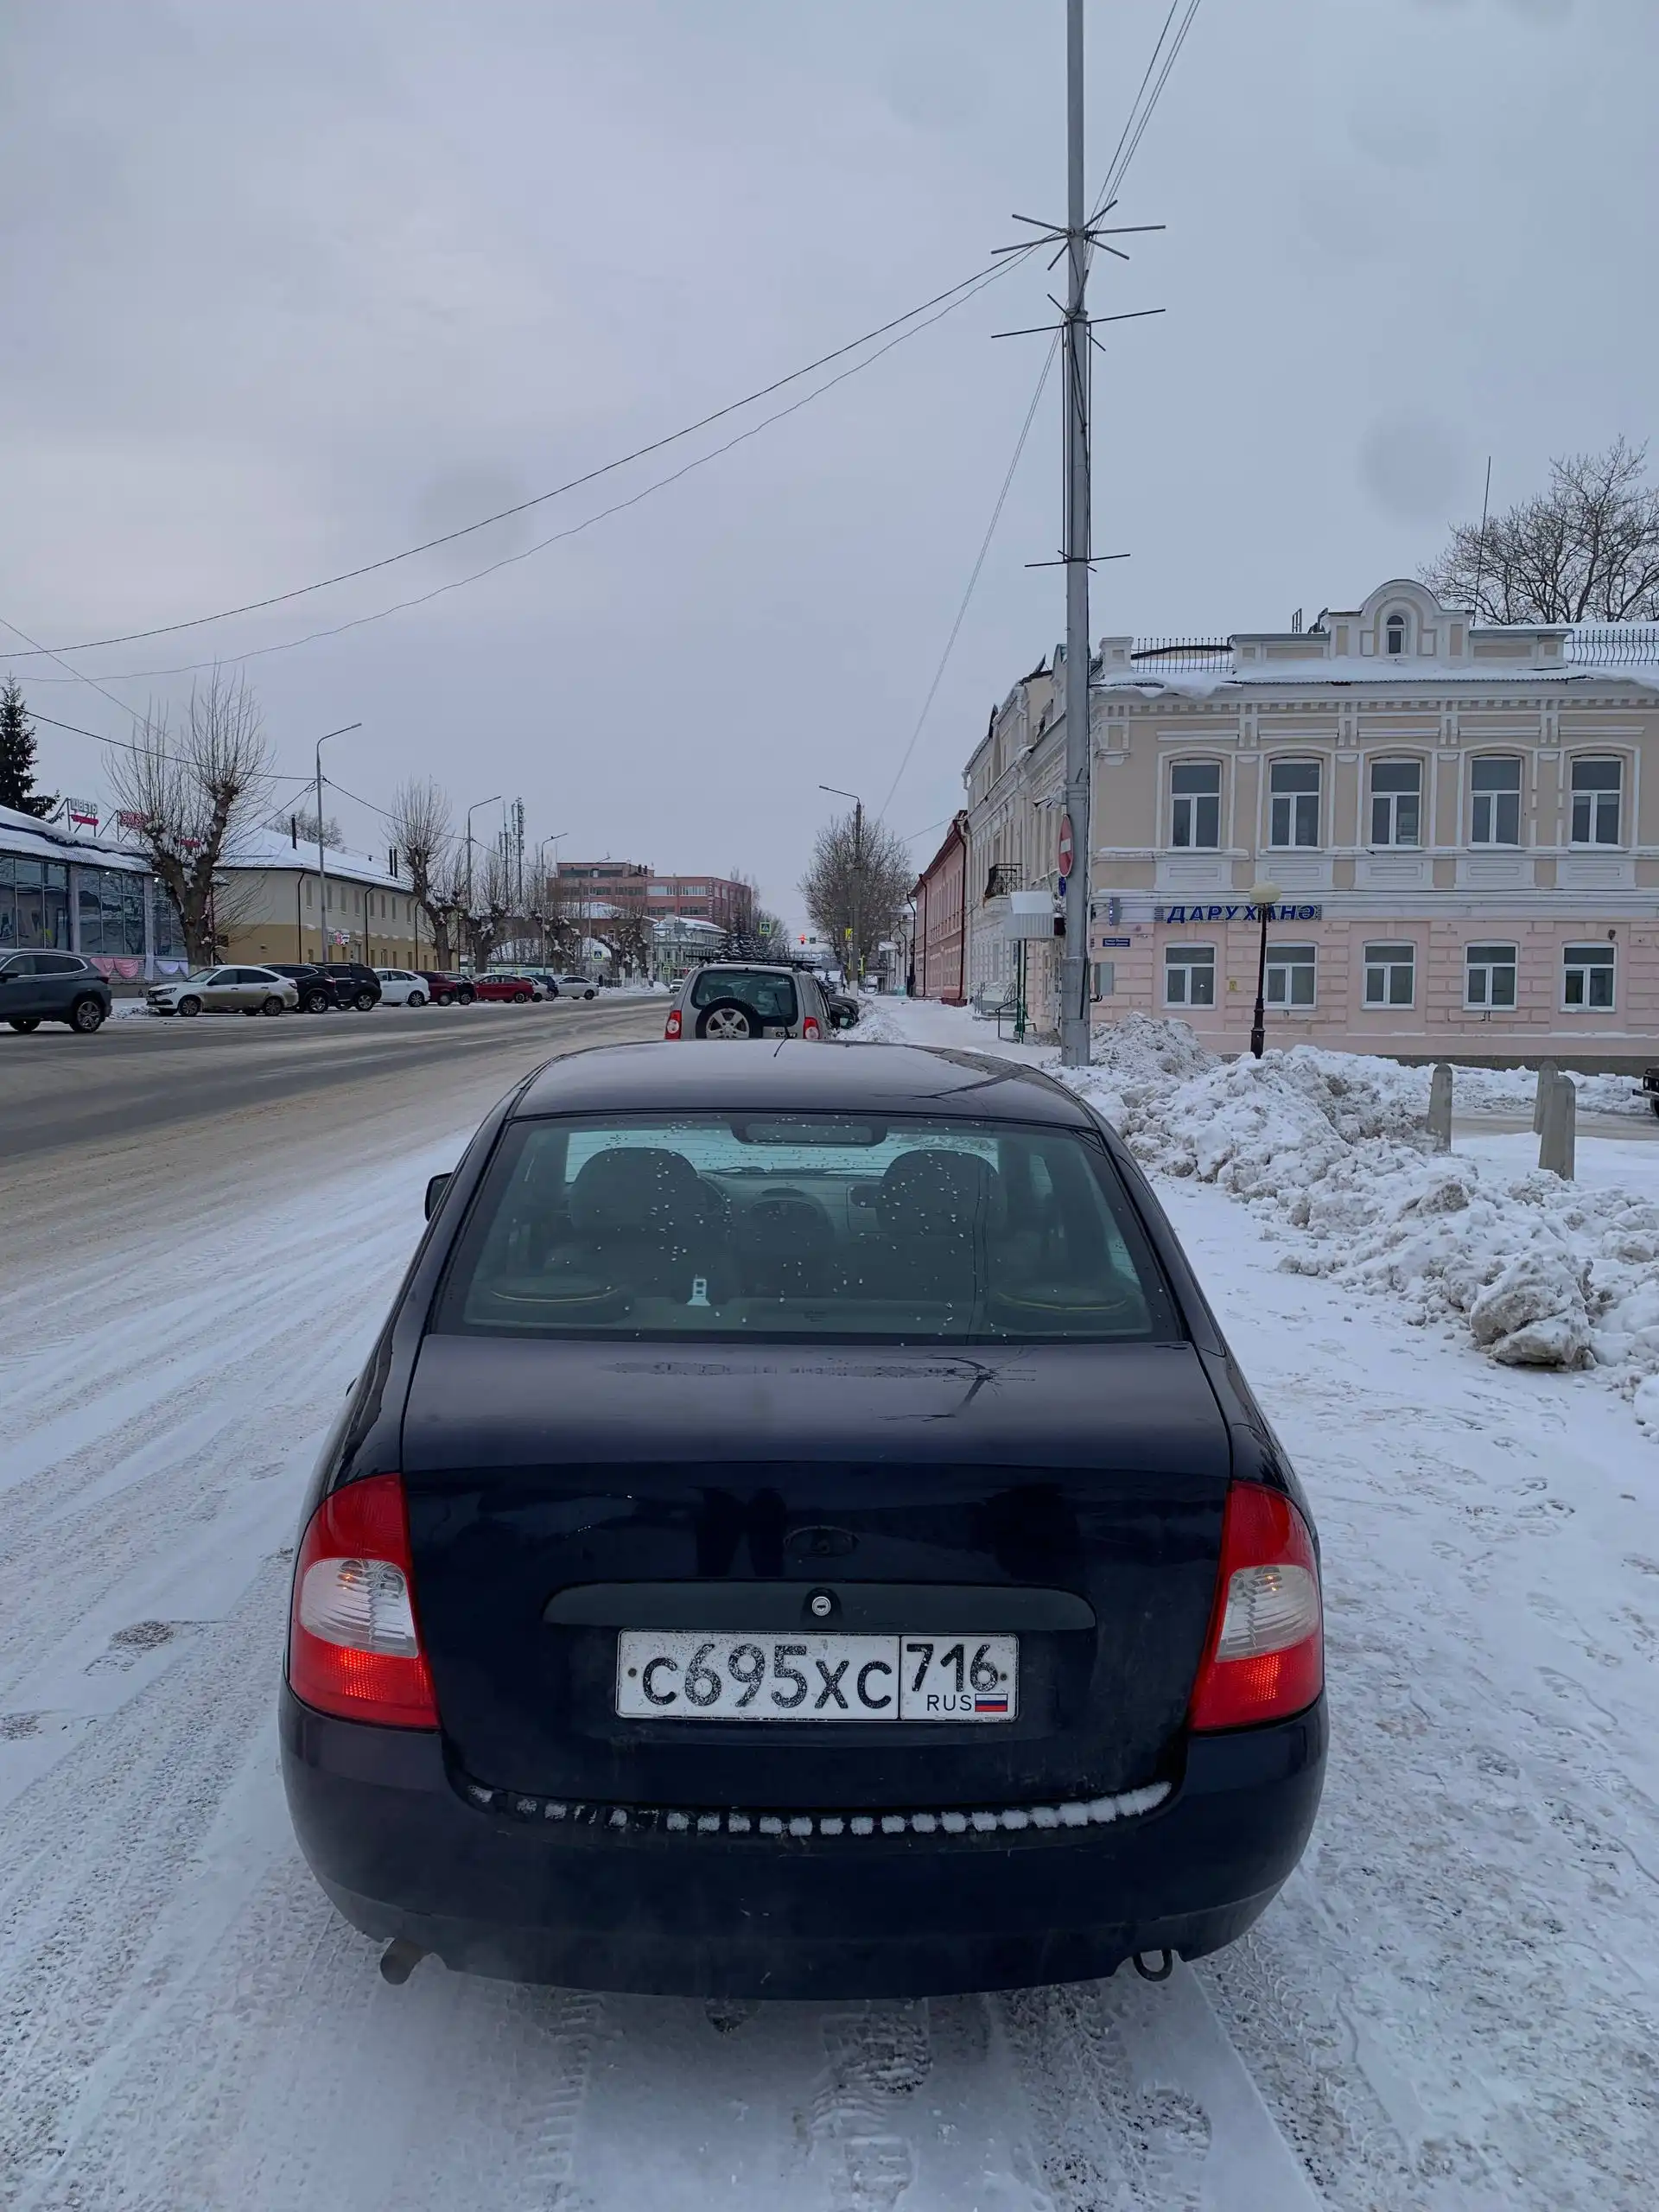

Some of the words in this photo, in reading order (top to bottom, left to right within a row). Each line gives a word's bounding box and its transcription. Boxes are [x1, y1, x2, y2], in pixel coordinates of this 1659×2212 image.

[642, 1643, 893, 1710] С695ХС
[906, 1643, 999, 1693] 716
[926, 1694, 972, 1712] RUS
